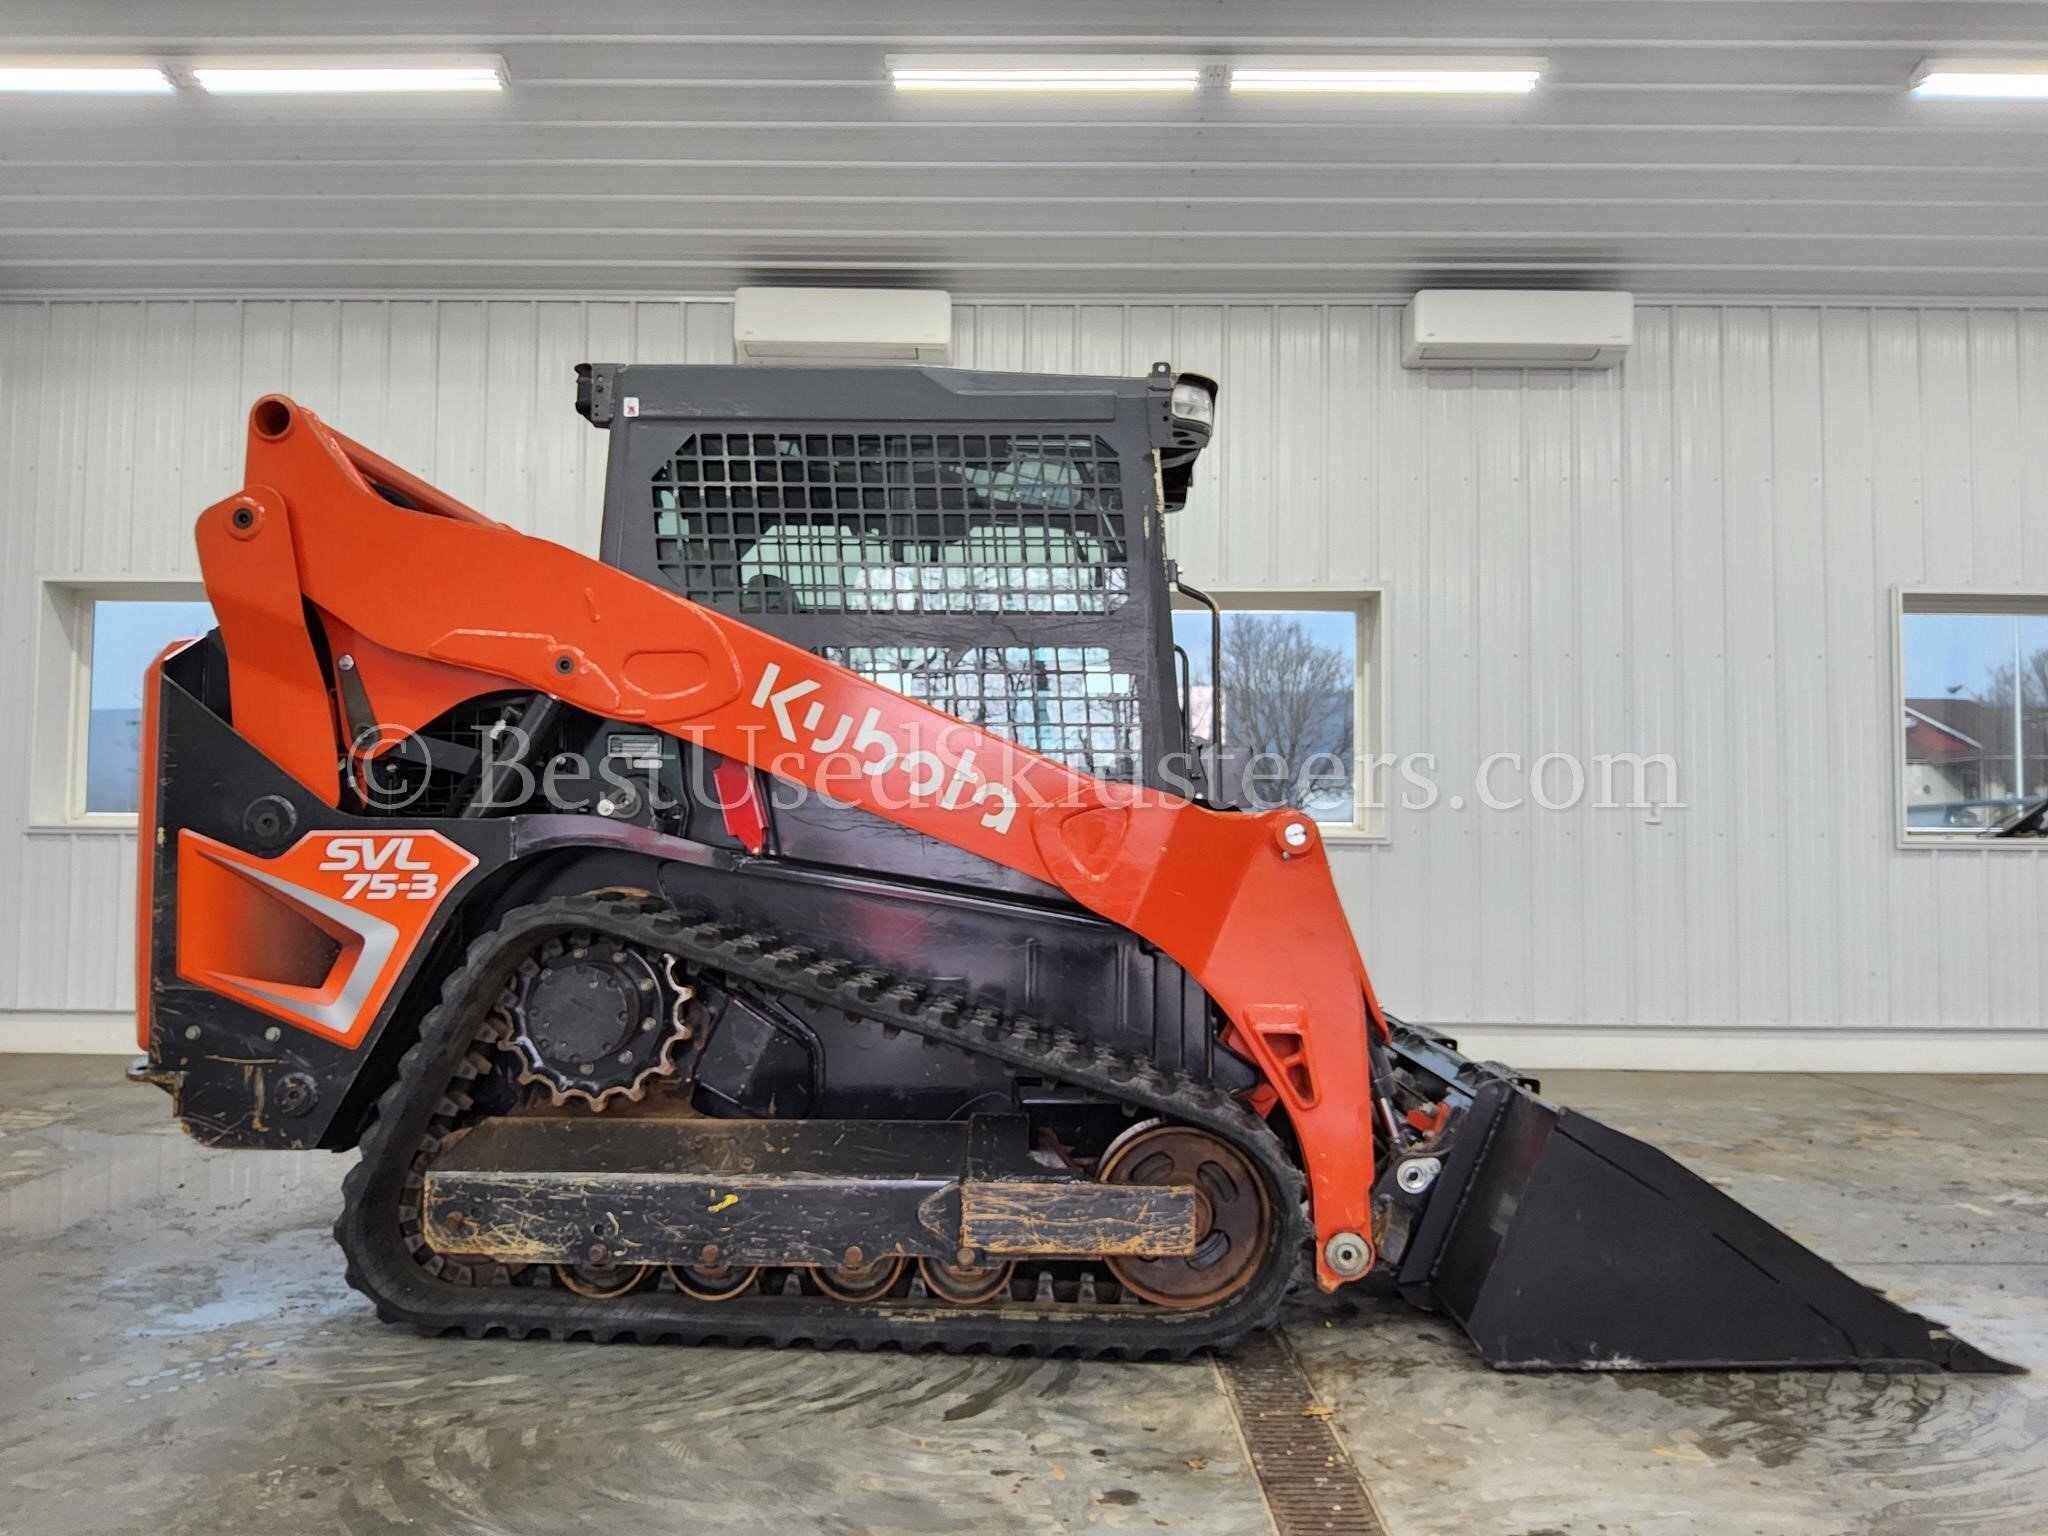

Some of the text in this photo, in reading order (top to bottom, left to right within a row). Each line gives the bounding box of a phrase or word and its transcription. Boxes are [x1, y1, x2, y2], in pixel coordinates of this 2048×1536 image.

[751, 662, 1016, 835] Kubota
[319, 838, 432, 871] SVL
[342, 873, 439, 900] 75-3
